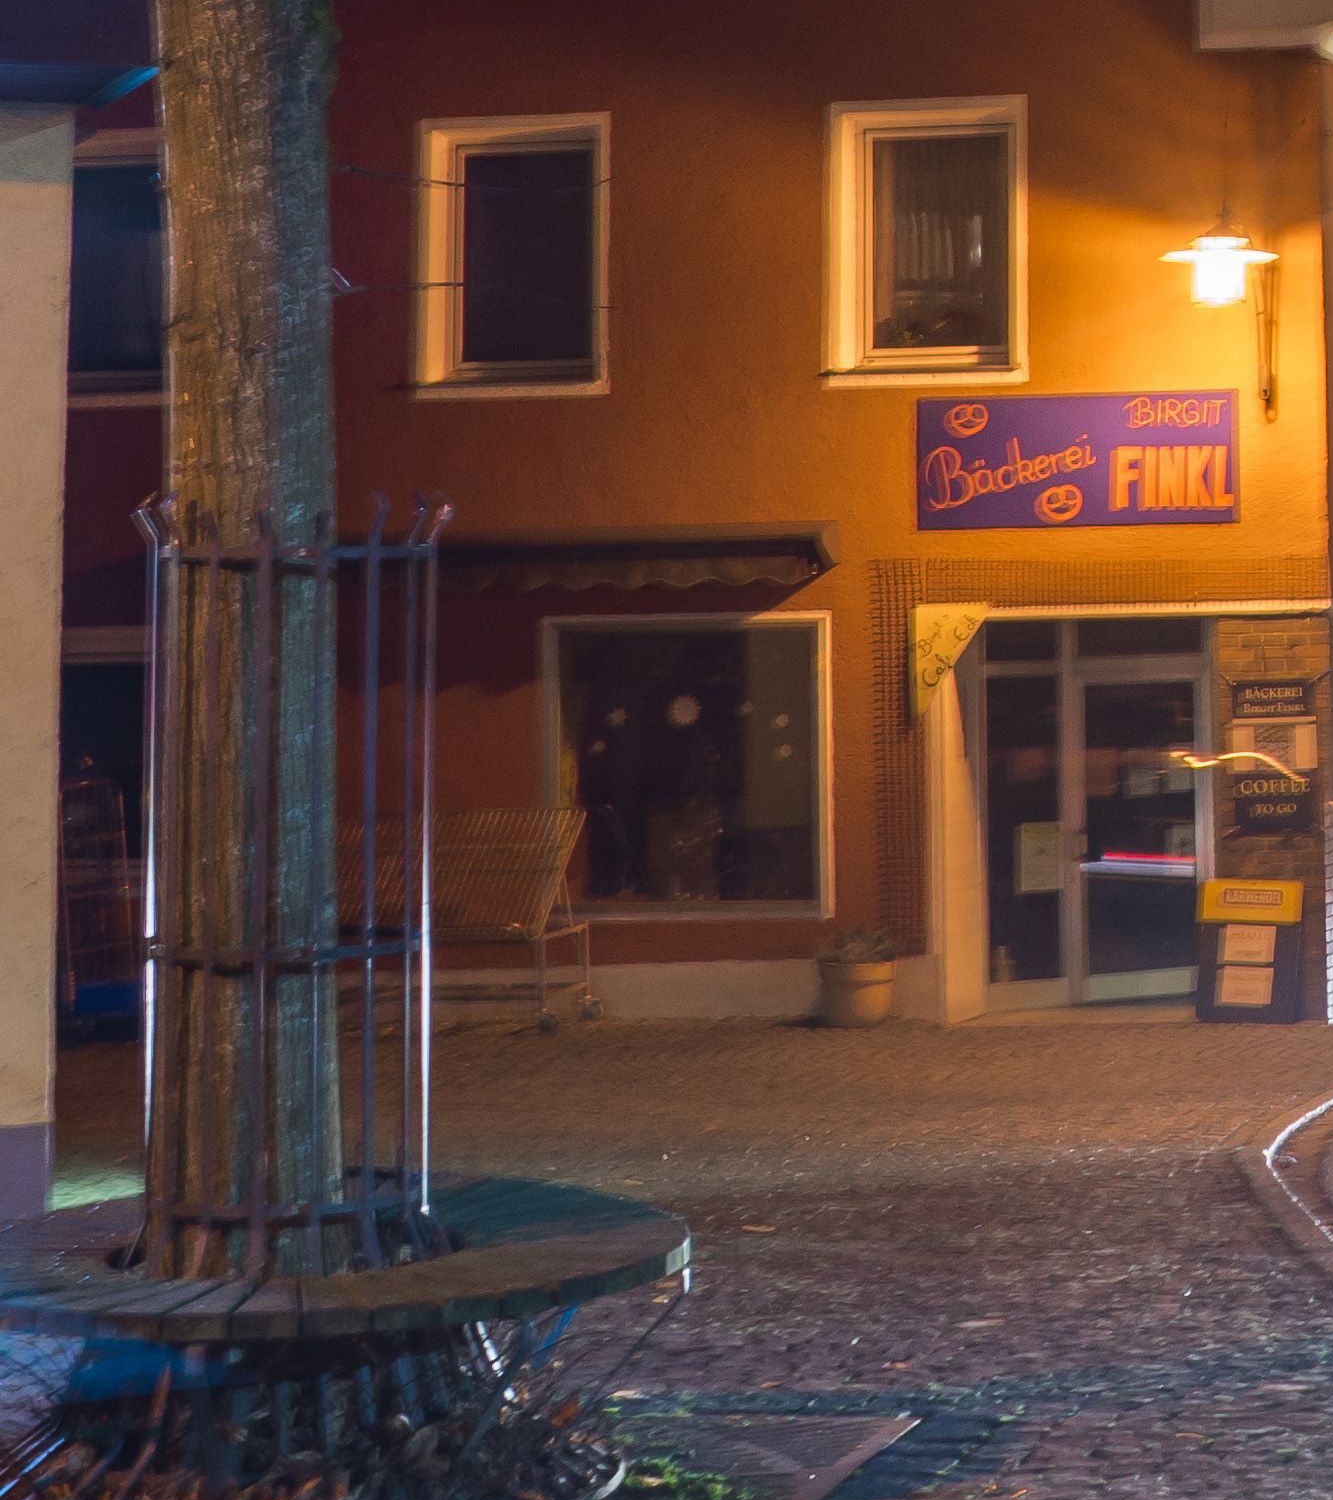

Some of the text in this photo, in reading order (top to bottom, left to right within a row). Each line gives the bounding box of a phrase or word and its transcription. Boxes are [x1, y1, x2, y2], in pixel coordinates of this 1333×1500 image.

[1126, 397, 1228, 427] BIRGIT
[924, 434, 1098, 510] Bäckerei
[1110, 445, 1235, 511] FINKL
[1244, 686, 1303, 699] BÄCKEREI
[1241, 779, 1312, 794] COFFEE
